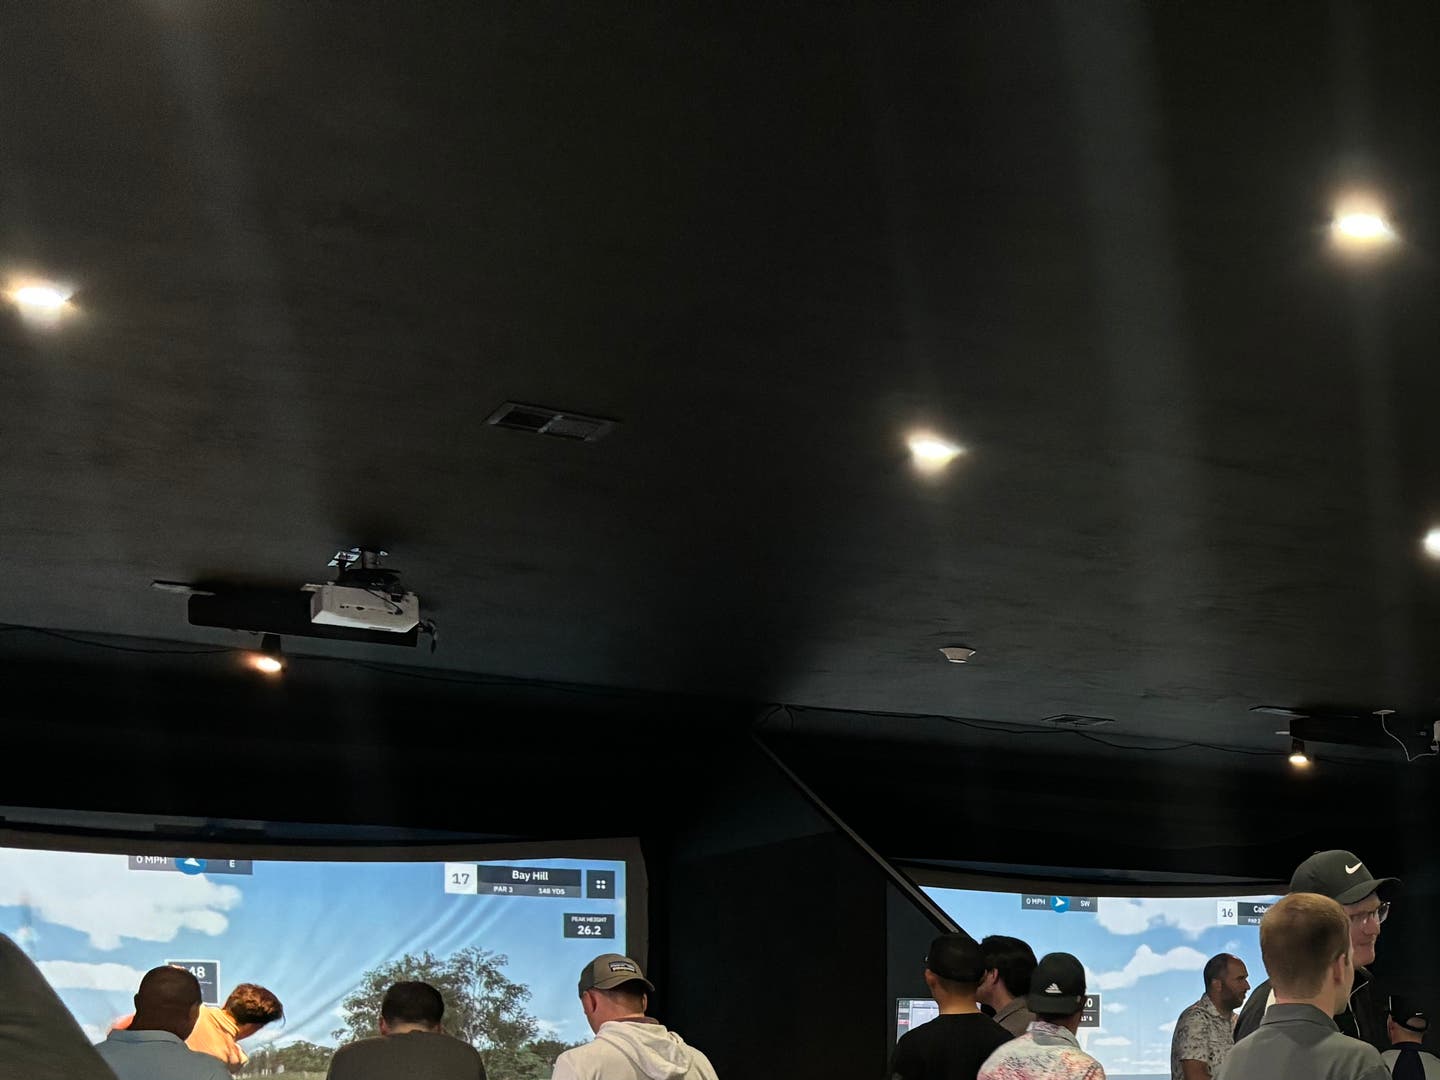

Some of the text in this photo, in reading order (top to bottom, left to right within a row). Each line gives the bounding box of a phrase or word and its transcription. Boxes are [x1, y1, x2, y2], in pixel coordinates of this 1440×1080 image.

[145, 856, 168, 865] MPH
[452, 873, 470, 885] 17
[511, 870, 549, 882] Bay Hill
[1222, 908, 1234, 918] 16
[577, 925, 602, 936] 26.2
